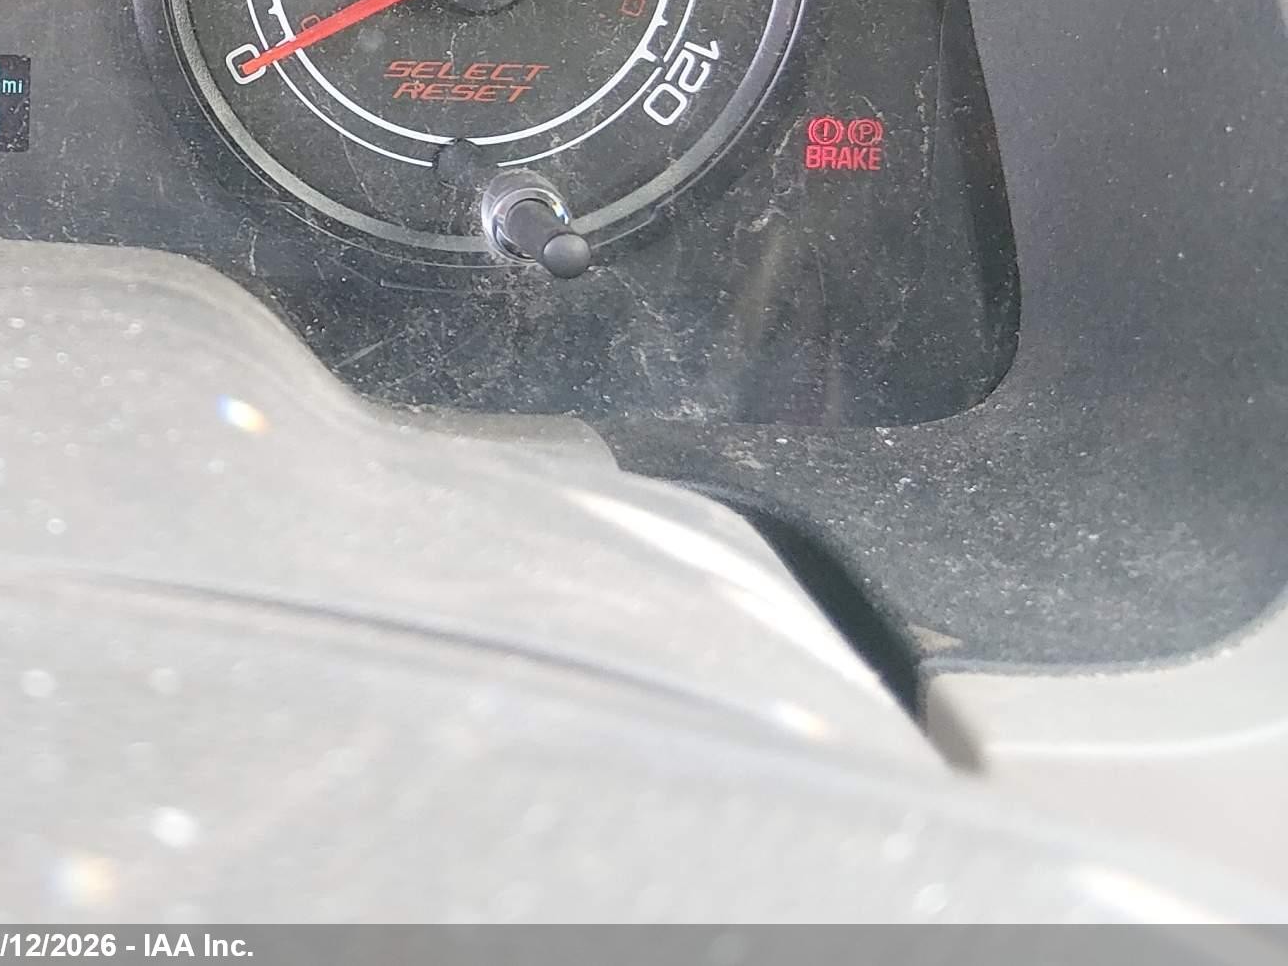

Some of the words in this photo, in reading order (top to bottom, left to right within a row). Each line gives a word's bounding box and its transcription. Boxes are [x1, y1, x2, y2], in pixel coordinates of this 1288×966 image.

[225, 43, 268, 85] 0
[383, 60, 551, 82] SELECT
[2, 78, 23, 94] mi
[392, 82, 534, 103] RESET
[643, 40, 720, 126] 120
[806, 145, 882, 170] BRAKE
